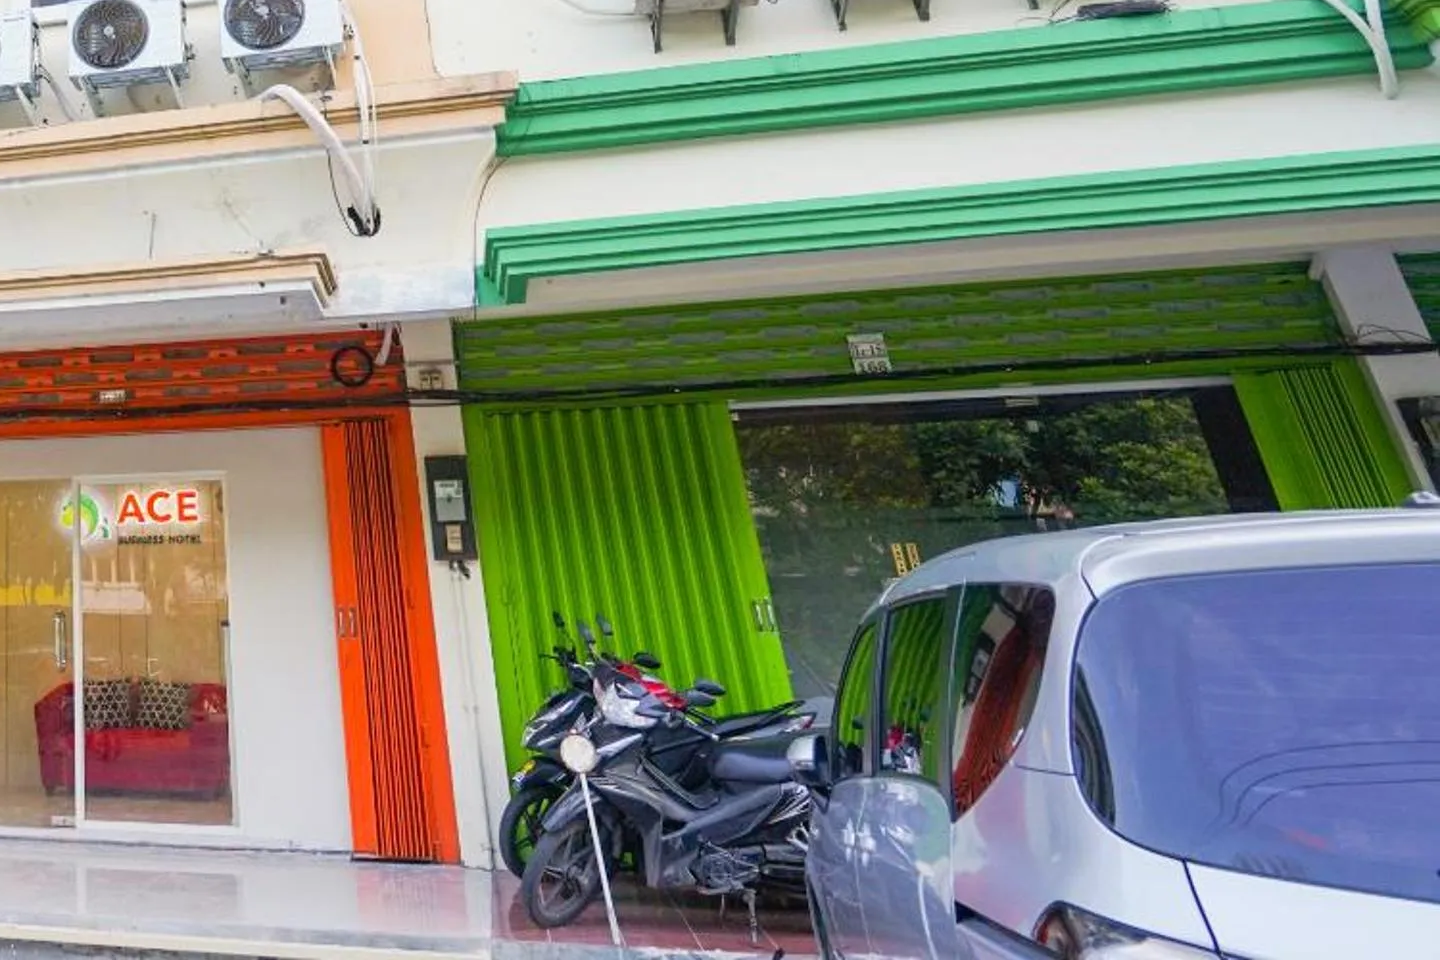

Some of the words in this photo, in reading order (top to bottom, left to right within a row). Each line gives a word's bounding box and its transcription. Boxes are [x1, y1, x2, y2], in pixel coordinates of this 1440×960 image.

[118, 491, 198, 523] ACE
[118, 535, 163, 545] BUSINESS
[169, 534, 202, 545] HOTEL
